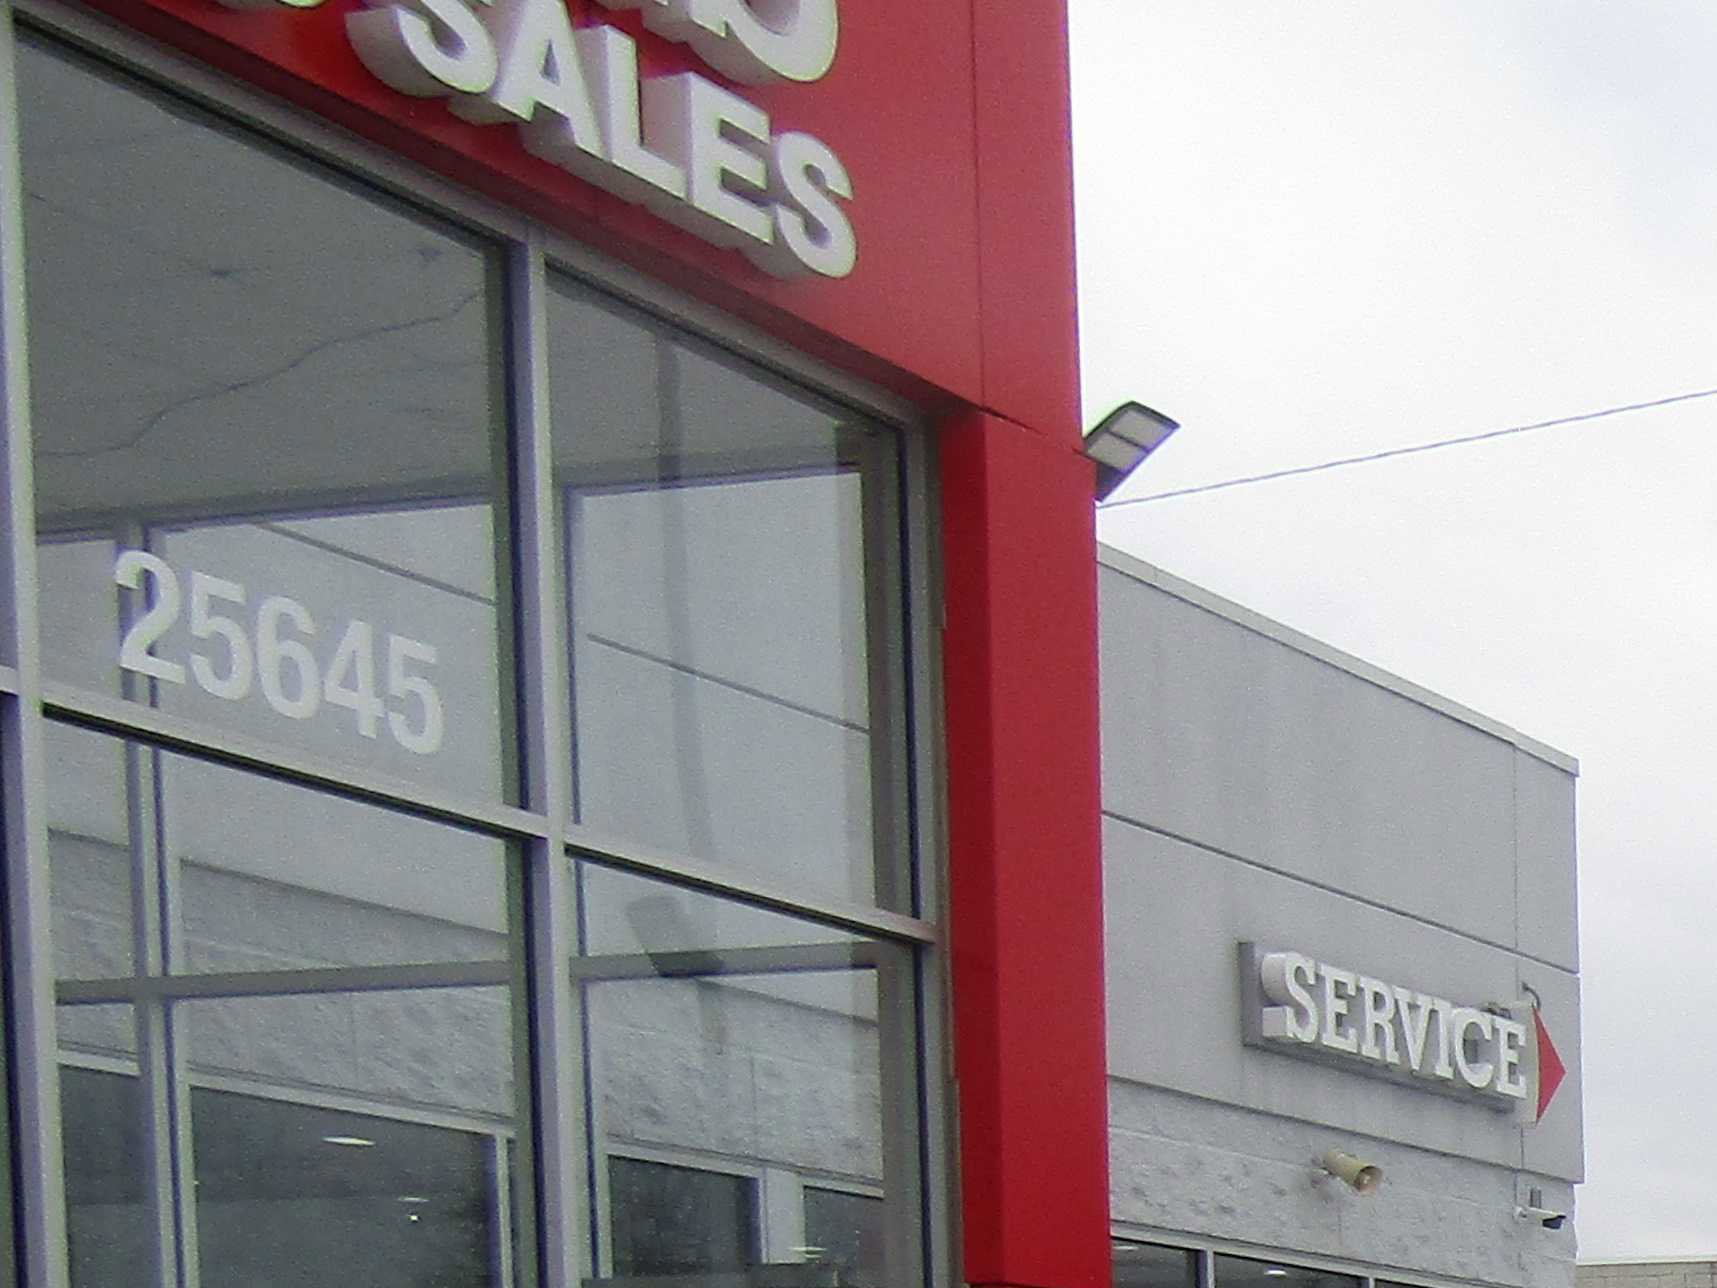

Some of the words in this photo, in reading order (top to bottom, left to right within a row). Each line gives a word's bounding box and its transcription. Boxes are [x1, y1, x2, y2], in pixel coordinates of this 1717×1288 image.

[366, 0, 856, 280] SALES
[115, 550, 443, 755] 25645
[1262, 953, 1527, 1099] SERVICE
